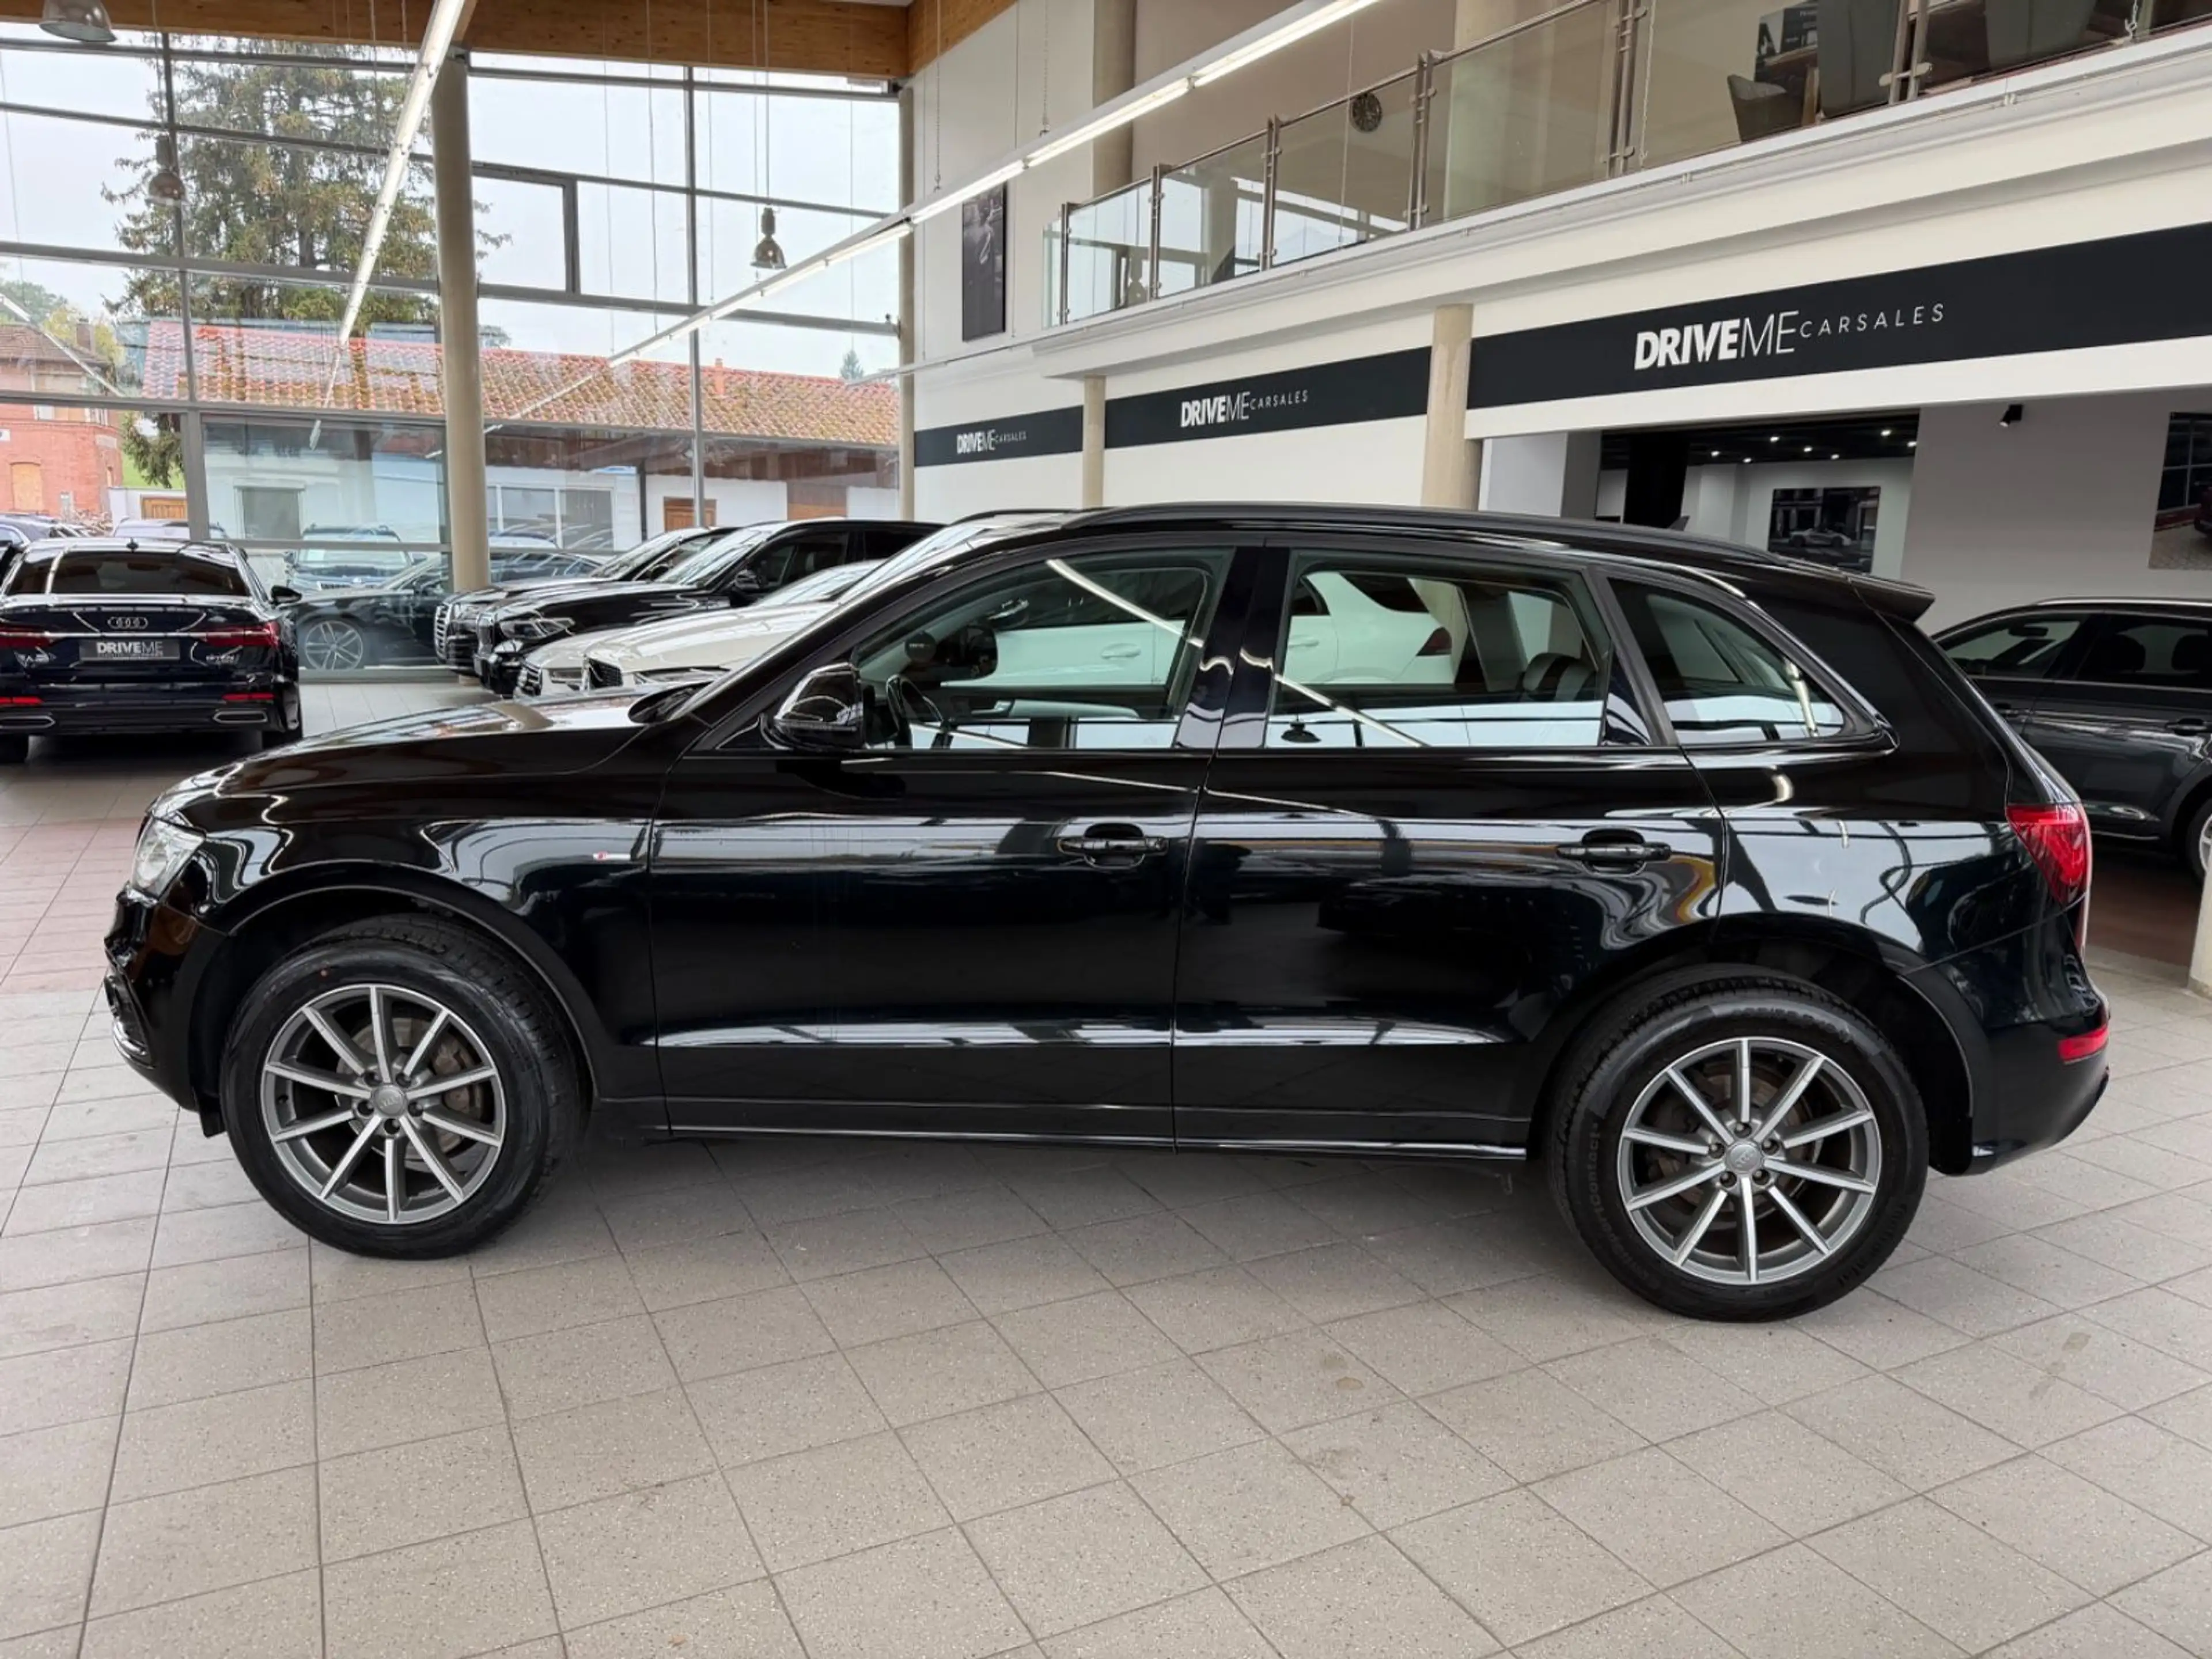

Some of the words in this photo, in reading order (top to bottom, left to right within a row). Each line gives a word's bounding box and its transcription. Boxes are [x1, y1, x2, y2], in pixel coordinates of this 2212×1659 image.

[1634, 310, 1799, 370] DRIVEME
[1800, 304, 1944, 338] CARSALES
[1180, 391, 1251, 427] DRIVEME
[1250, 390, 1309, 410] CARSALES
[96, 641, 163, 654] DRIVEME
